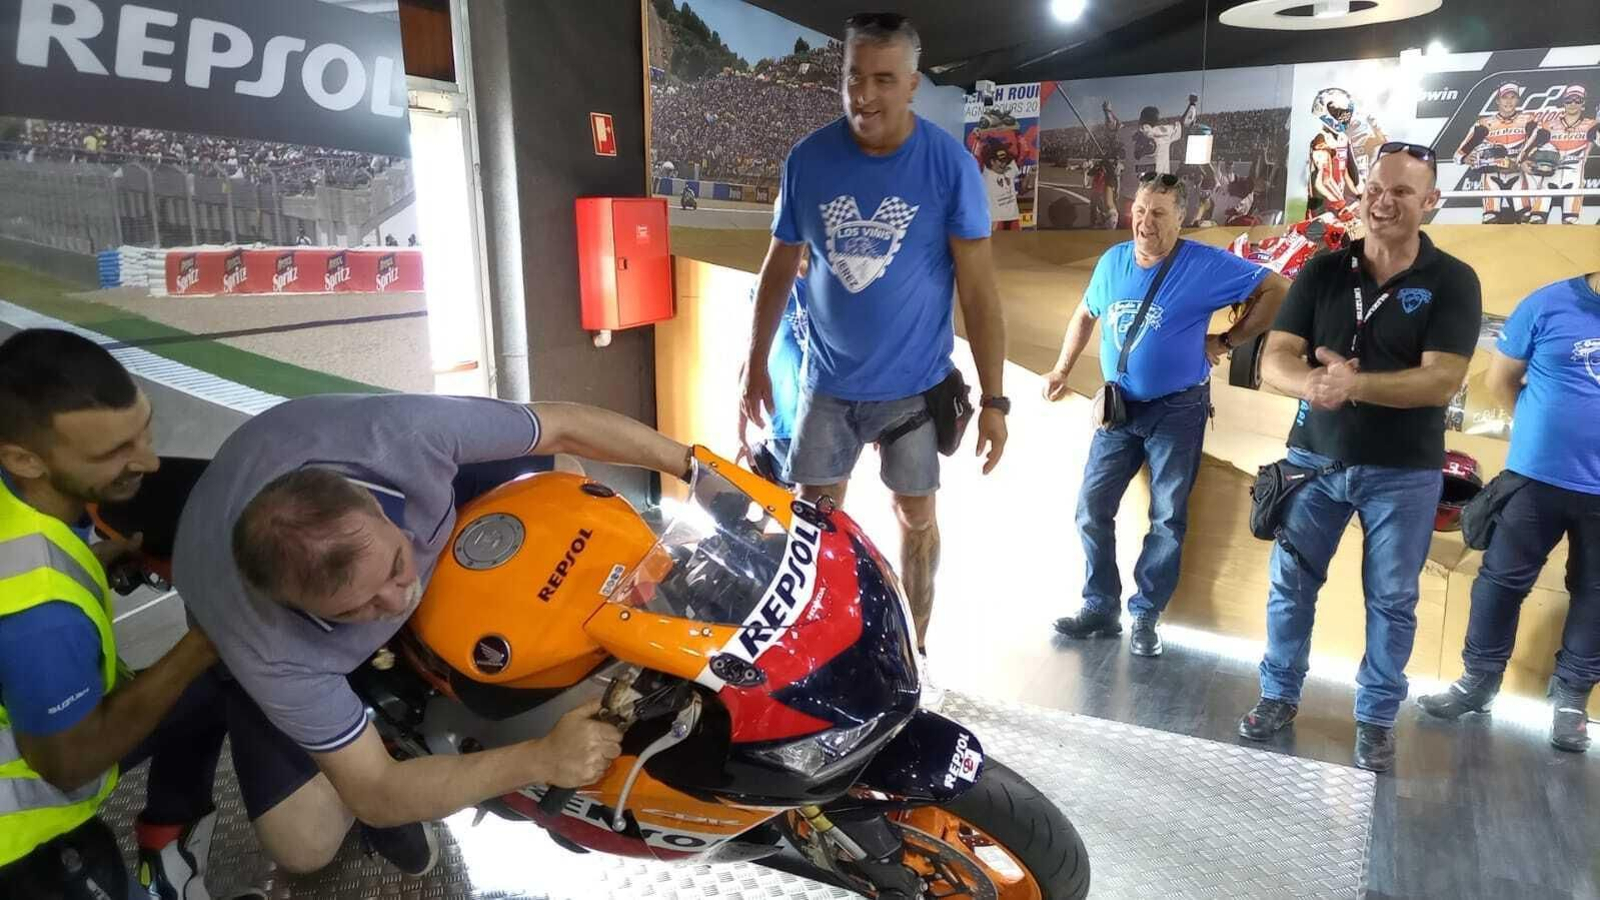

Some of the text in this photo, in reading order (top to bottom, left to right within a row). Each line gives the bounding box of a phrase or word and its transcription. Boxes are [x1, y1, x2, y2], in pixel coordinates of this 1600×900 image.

[16, 0, 404, 118] REPSOL
[837, 227, 860, 239] LOS
[324, 266, 351, 291] Spritz
[376, 266, 399, 292] Spritz
[537, 528, 593, 602] REPSOL
[739, 526, 818, 658] REPSOL
[944, 733, 970, 789] REPSOL
